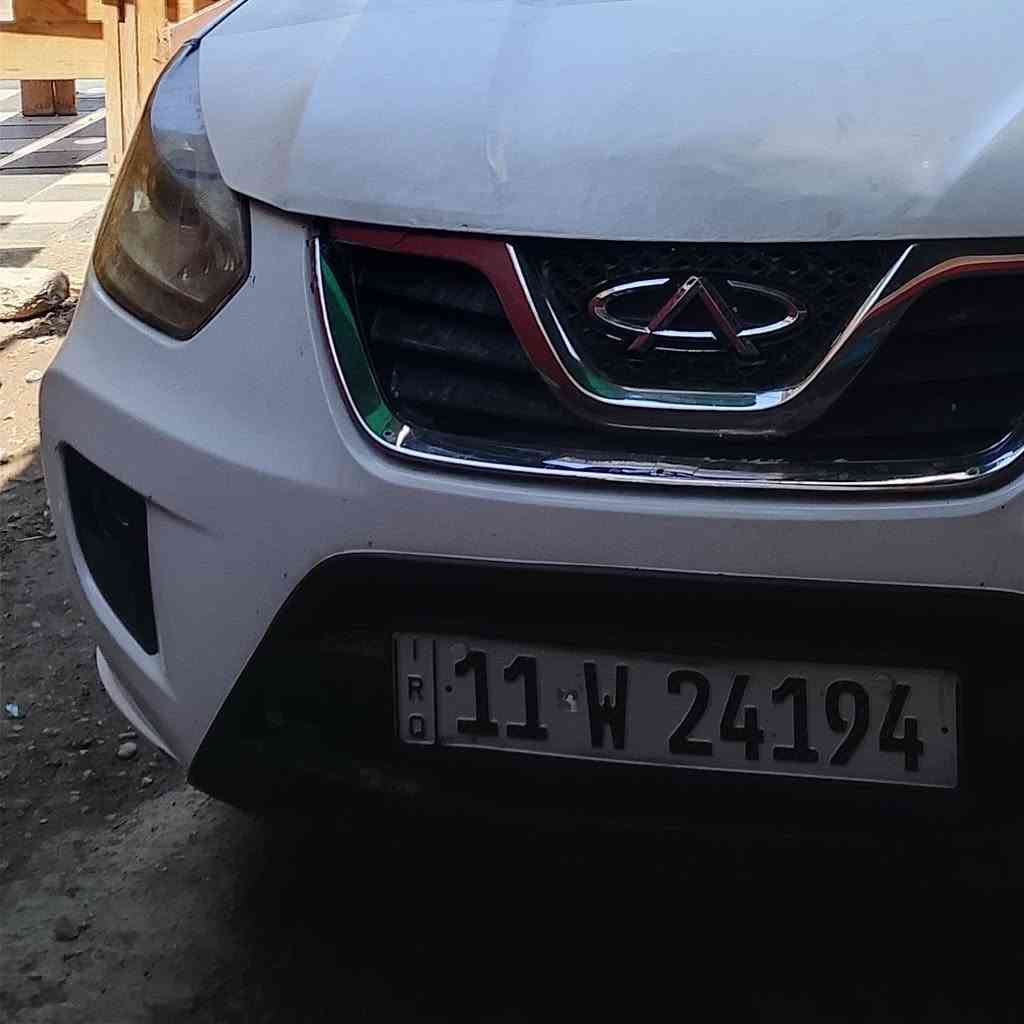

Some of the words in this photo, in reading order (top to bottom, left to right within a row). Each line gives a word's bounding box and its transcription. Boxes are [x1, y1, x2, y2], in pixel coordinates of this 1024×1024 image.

[454, 650, 548, 740] 11
[583, 660, 629, 750] W
[666, 670, 925, 772] 24194
